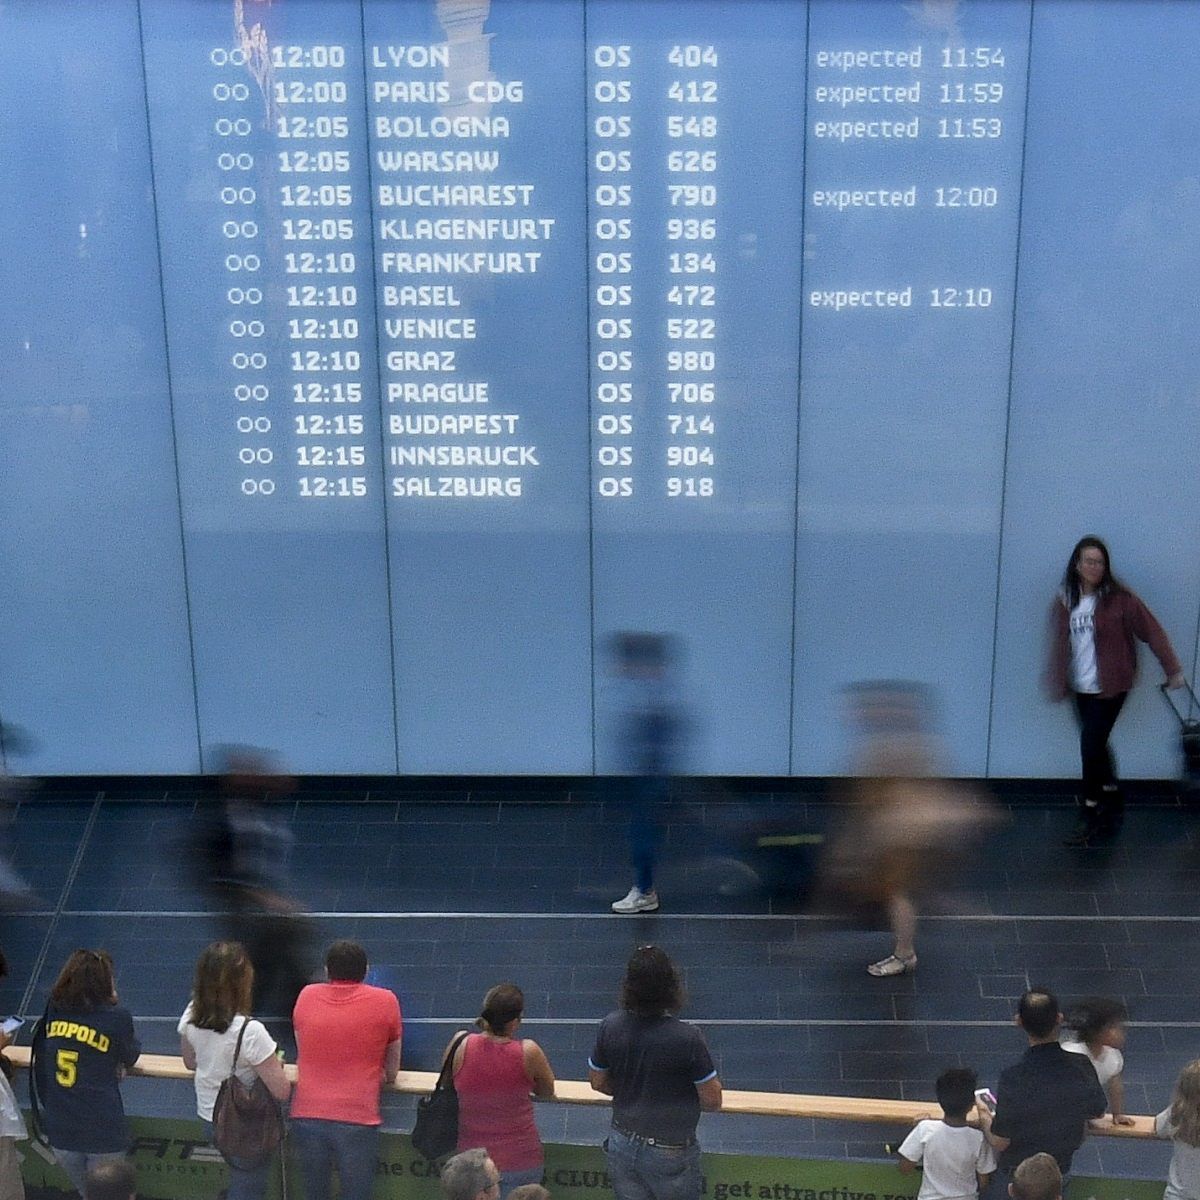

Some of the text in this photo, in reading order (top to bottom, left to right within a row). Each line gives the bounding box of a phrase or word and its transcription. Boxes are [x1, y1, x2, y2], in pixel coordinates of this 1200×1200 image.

[271, 46, 1005, 73] 12:00 LYON OS 404 expected 11:54
[274, 81, 1004, 108] 12:00 PARIS CDG OS 412 expected 11:59
[277, 115, 1002, 143] 12:05 BOLOGNA OS 548 expected 11:53
[279, 151, 717, 173] 12:05 WARSAW OS 626
[281, 185, 998, 212] 12:05 BUCHAREST OS 790 expected 12:00
[283, 219, 716, 241] 12:05 KLAGENFURT OS 936
[285, 253, 716, 274] 12:10 FRANKFURT OS 134
[287, 285, 992, 312] 12:10 BASEL OS 472 expected 12:10
[289, 319, 716, 340] 12:10 VENICE OS 522
[292, 351, 715, 372] 12:10 GRAZ OS 980
[293, 383, 715, 404] 12:15 PRAGUE OS 706
[295, 415, 715, 435] 12:15 BUDAPEST OS 714
[297, 446, 714, 467] 12:15 INNSBRUCK OS 904
[299, 477, 714, 497] 12:15 SALZBURG OS 918
[55, 1048, 80, 1089] 5
